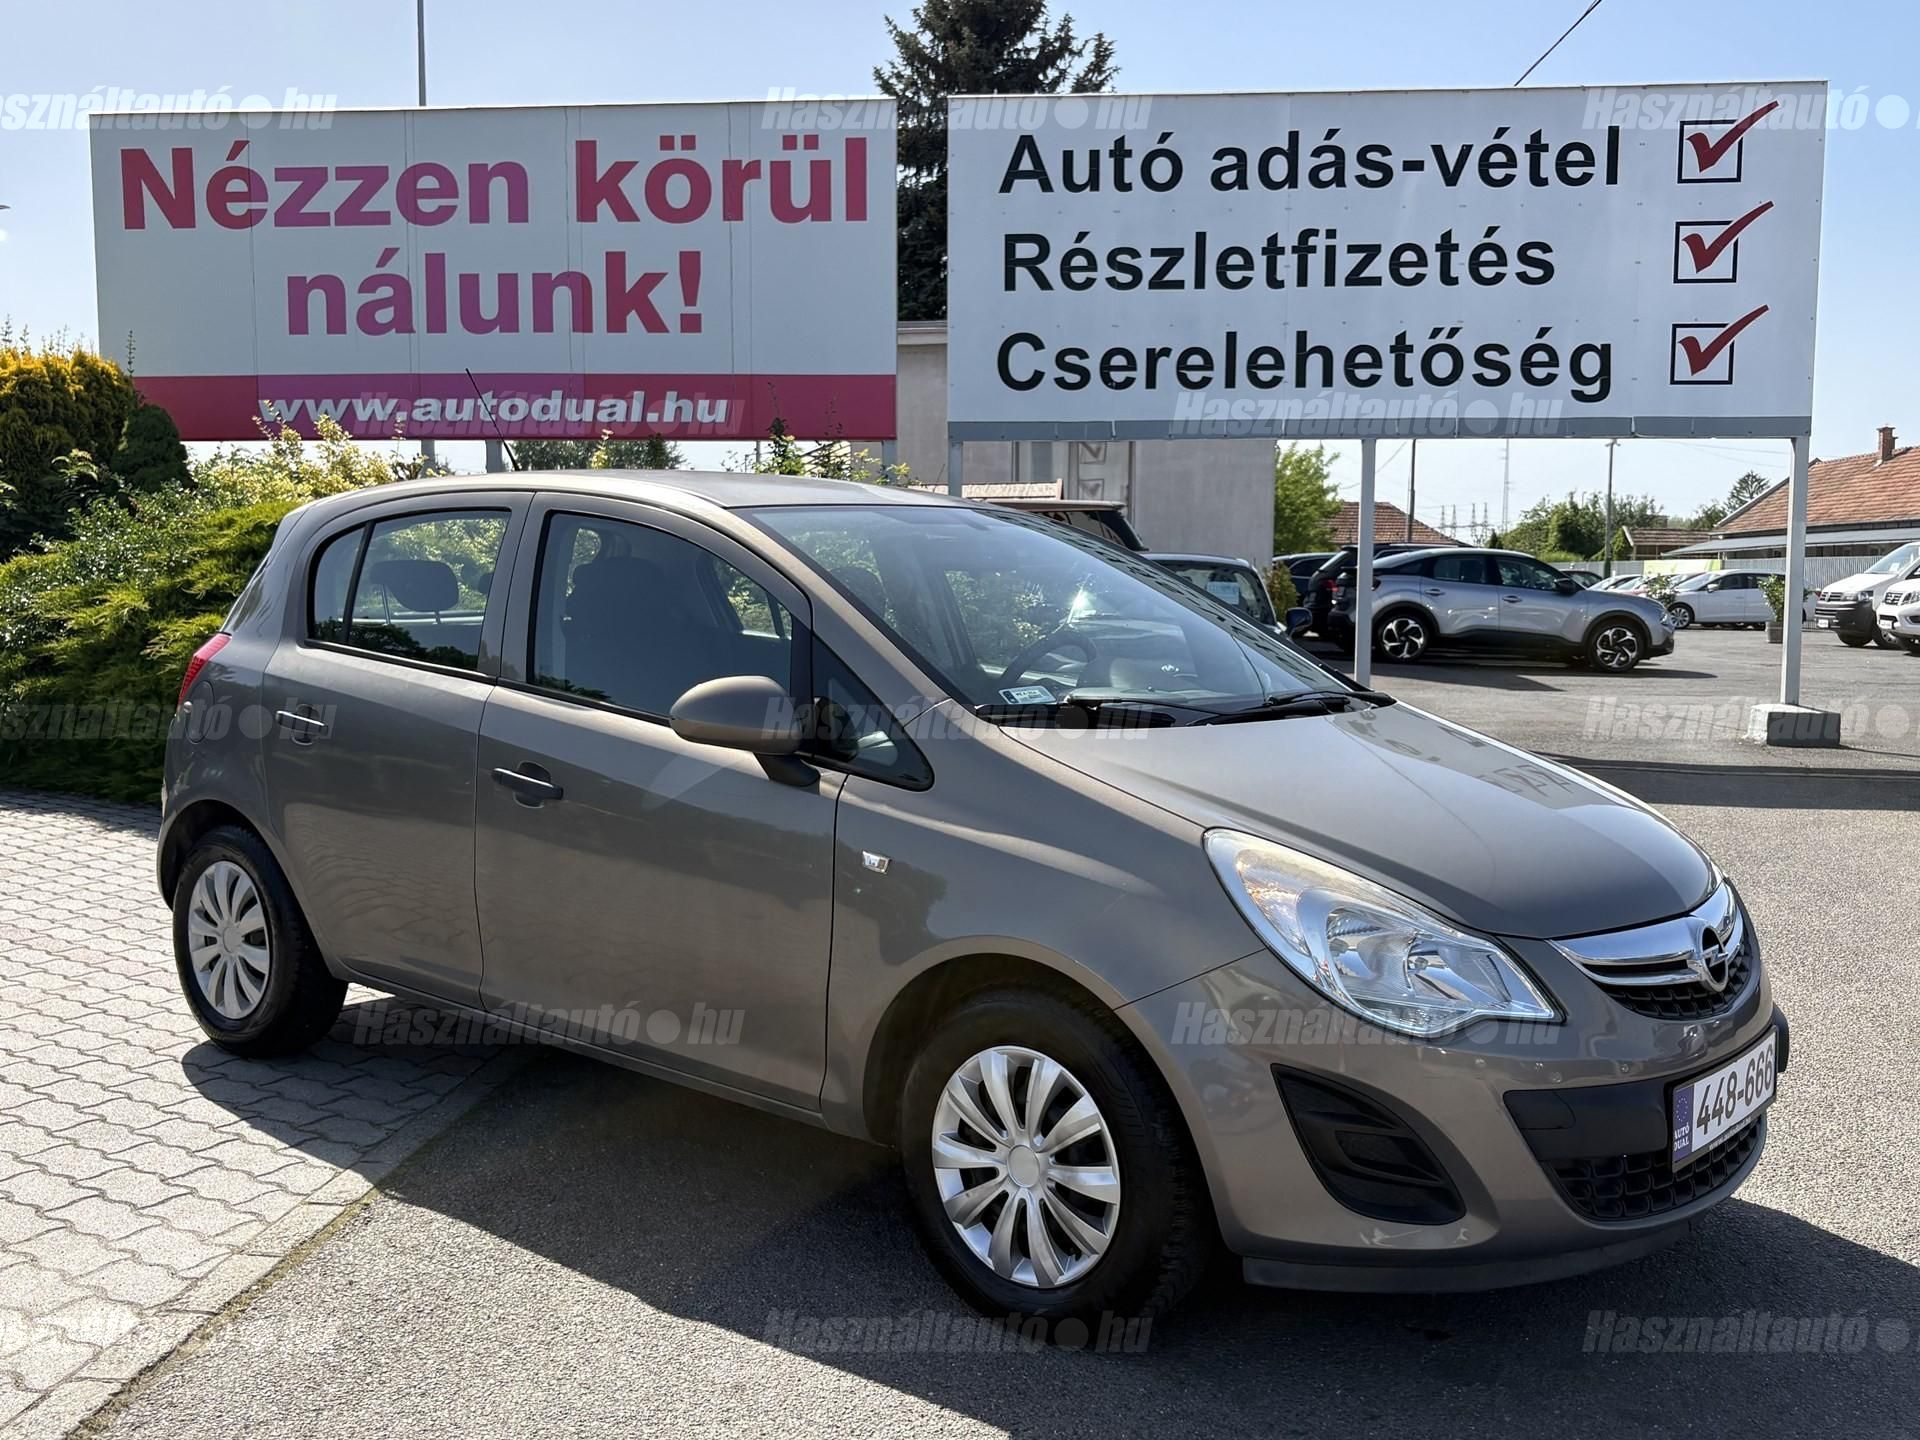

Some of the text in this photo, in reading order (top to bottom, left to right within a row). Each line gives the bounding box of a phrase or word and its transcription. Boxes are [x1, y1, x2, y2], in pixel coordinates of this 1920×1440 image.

[121, 135, 869, 230] Nézzen körül
[998, 125, 1620, 194] Autó adás-vétel
[286, 247, 703, 336] nálunk!
[1003, 225, 1556, 293] Részletfizetés
[996, 325, 1612, 404] Cserelehetőség
[258, 390, 729, 426] www.autodual.hu
[1696, 1043, 1773, 1136] 448-666
